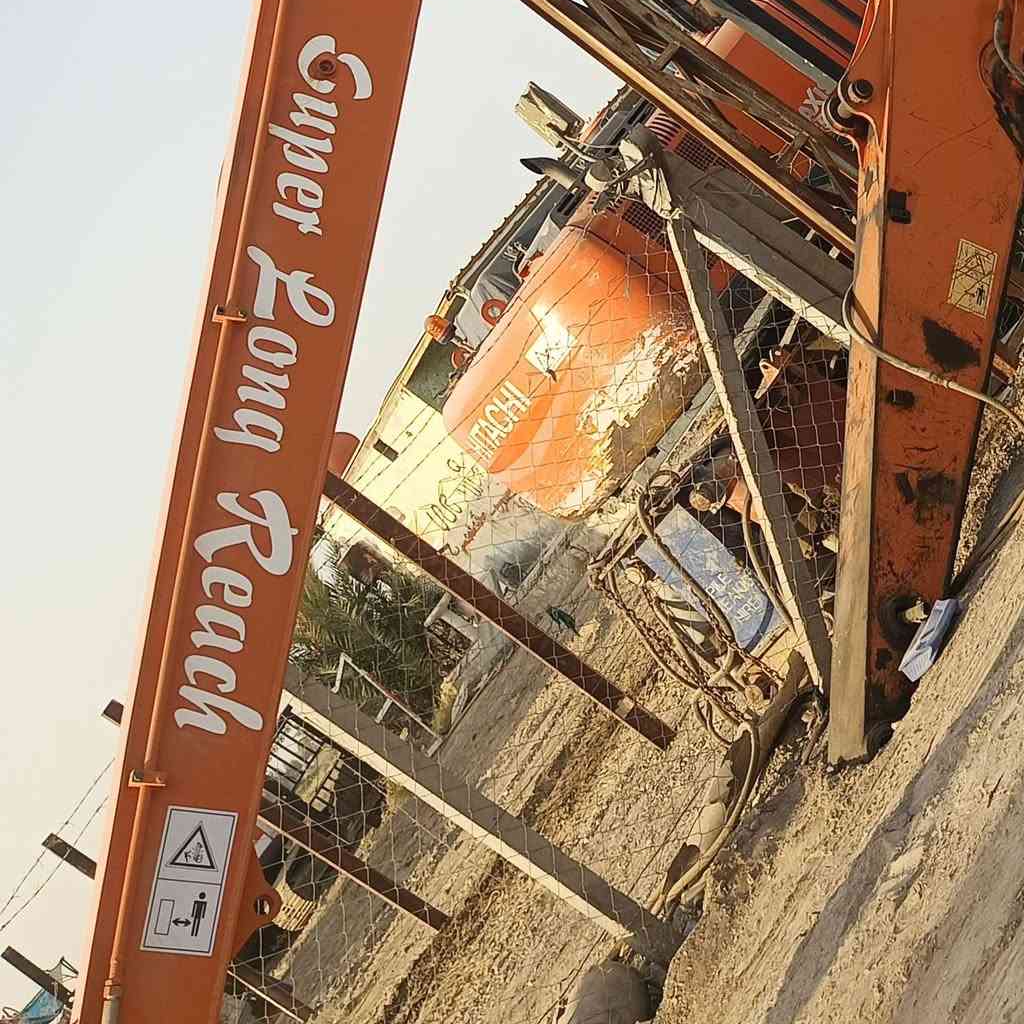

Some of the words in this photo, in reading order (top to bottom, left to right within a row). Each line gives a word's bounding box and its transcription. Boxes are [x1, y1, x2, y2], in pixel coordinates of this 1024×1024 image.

[267, 34, 373, 238] Super
[213, 245, 335, 453] Long
[465, 381, 531, 464] HITACHI
[173, 490, 301, 736] Reach
